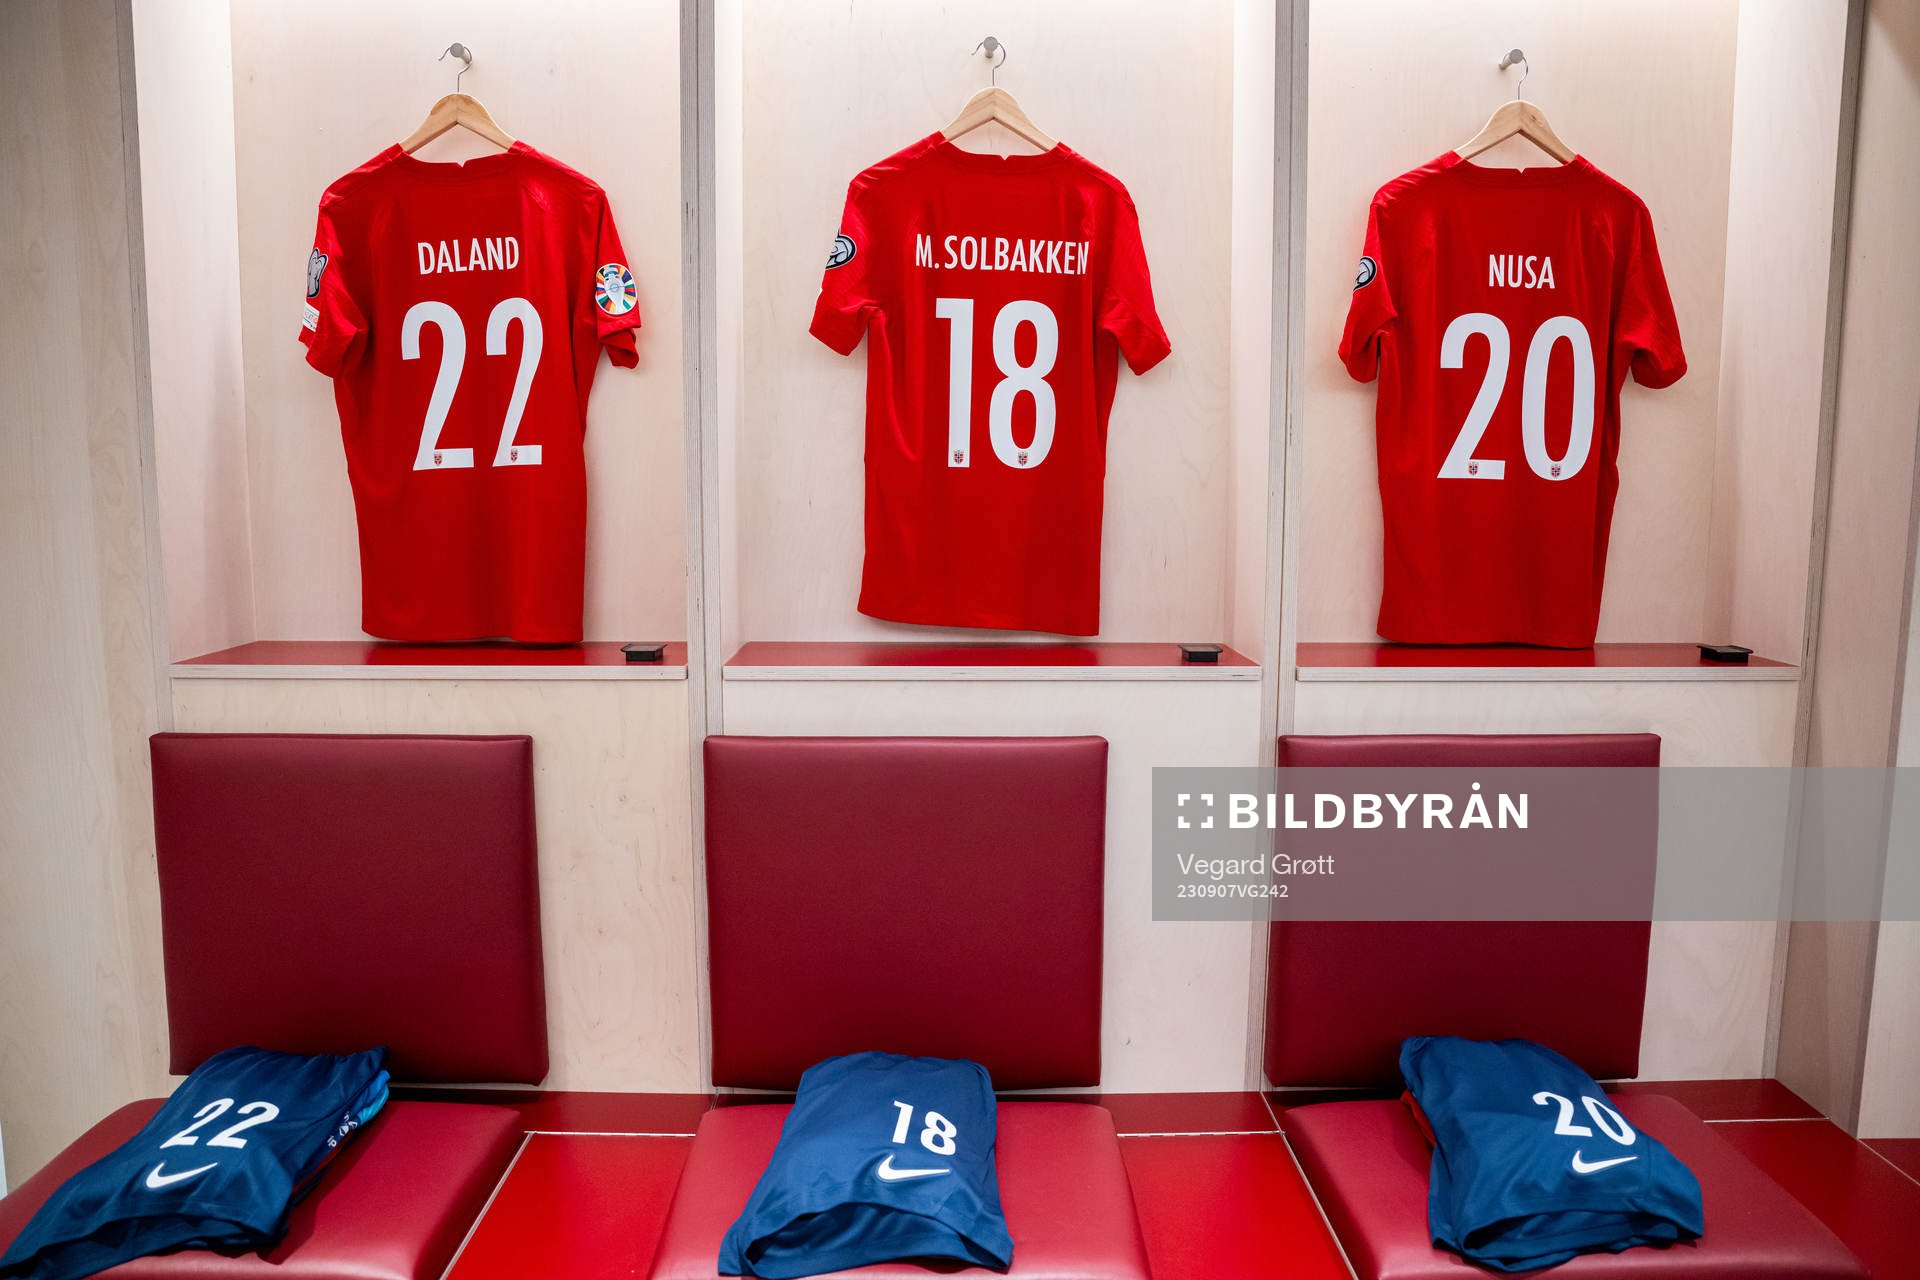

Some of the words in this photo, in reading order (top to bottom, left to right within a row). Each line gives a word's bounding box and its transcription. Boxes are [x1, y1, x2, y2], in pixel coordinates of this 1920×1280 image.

[417, 236, 519, 275] DALAND
[1488, 254, 1556, 290] NUSA
[401, 297, 544, 471] 22
[935, 297, 1059, 469] 18
[1437, 312, 1596, 481] 20
[159, 1097, 281, 1150] 22
[892, 1100, 958, 1156] 18
[1532, 1090, 1637, 1147] 20
